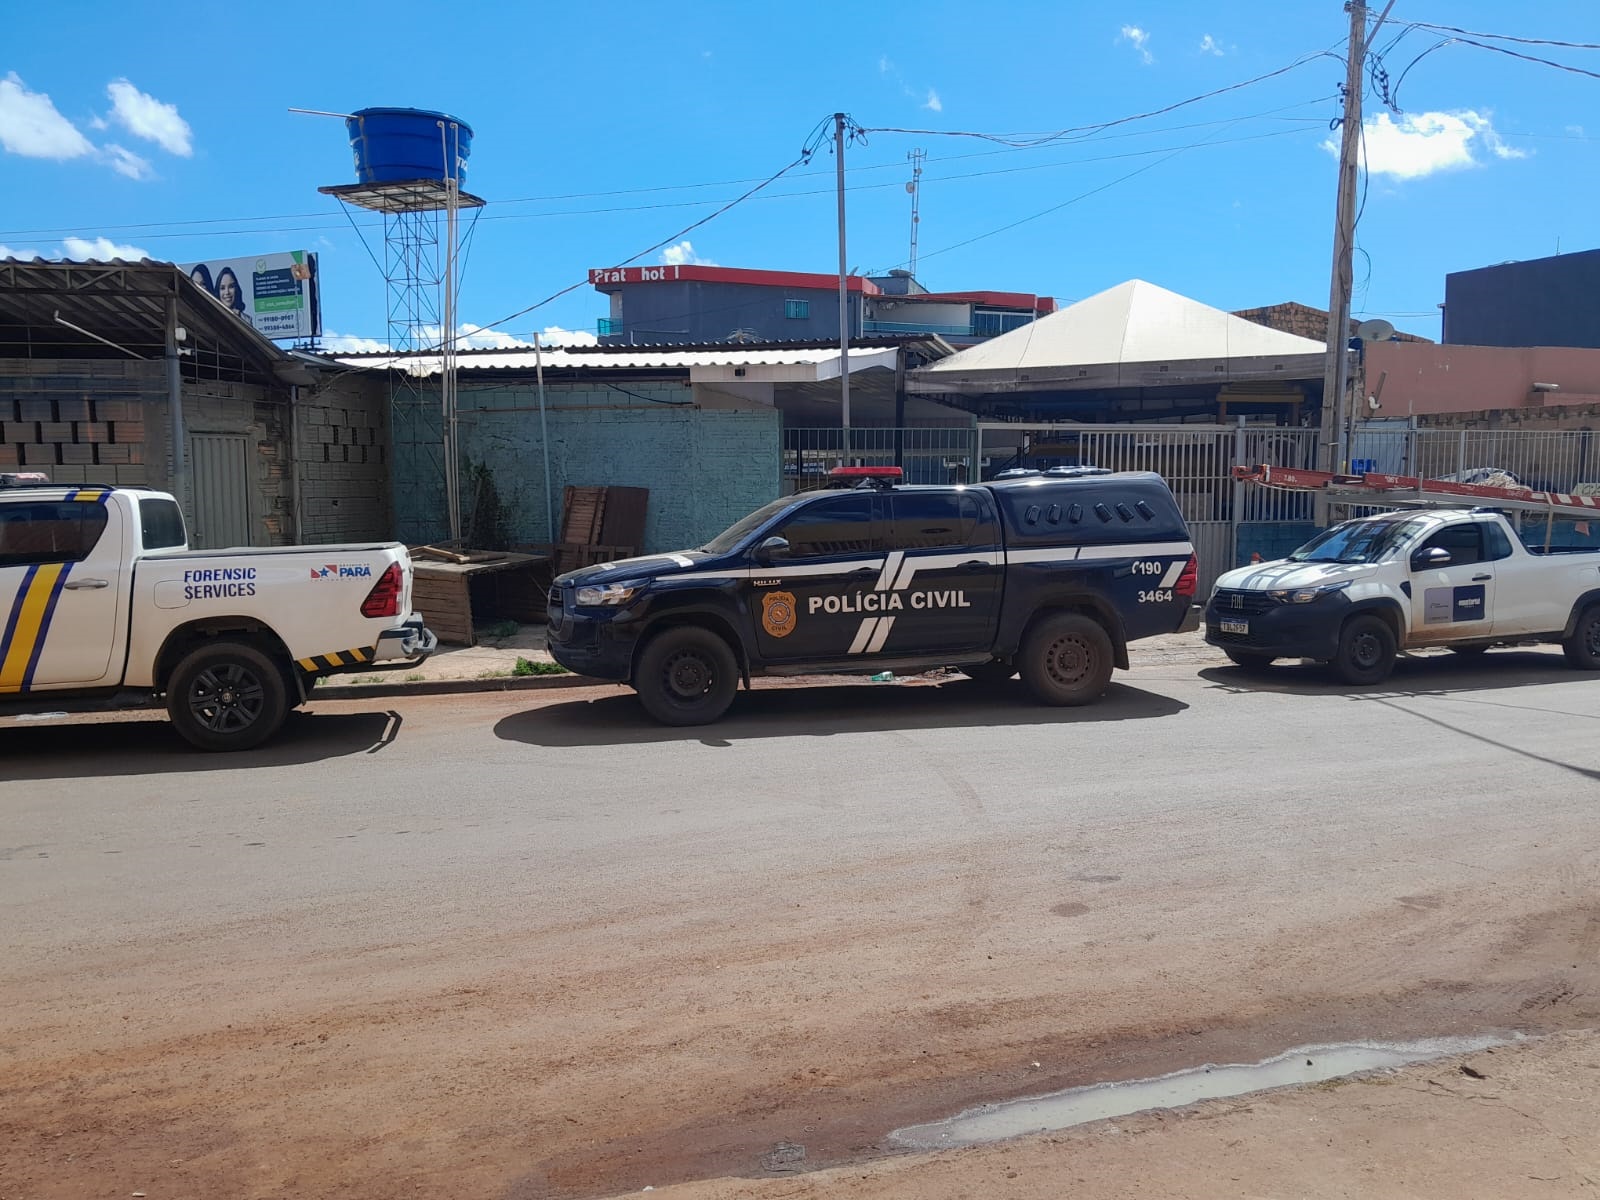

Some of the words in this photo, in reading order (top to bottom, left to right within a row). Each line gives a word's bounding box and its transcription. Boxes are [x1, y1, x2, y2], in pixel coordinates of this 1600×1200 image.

[184, 568, 256, 582] FORENSIC
[1139, 561, 1161, 575] 190
[184, 583, 256, 599] SERVICES
[1138, 590, 1173, 602] 3464
[809, 591, 903, 614] POLÍCIA
[910, 591, 971, 608] CIVIL
